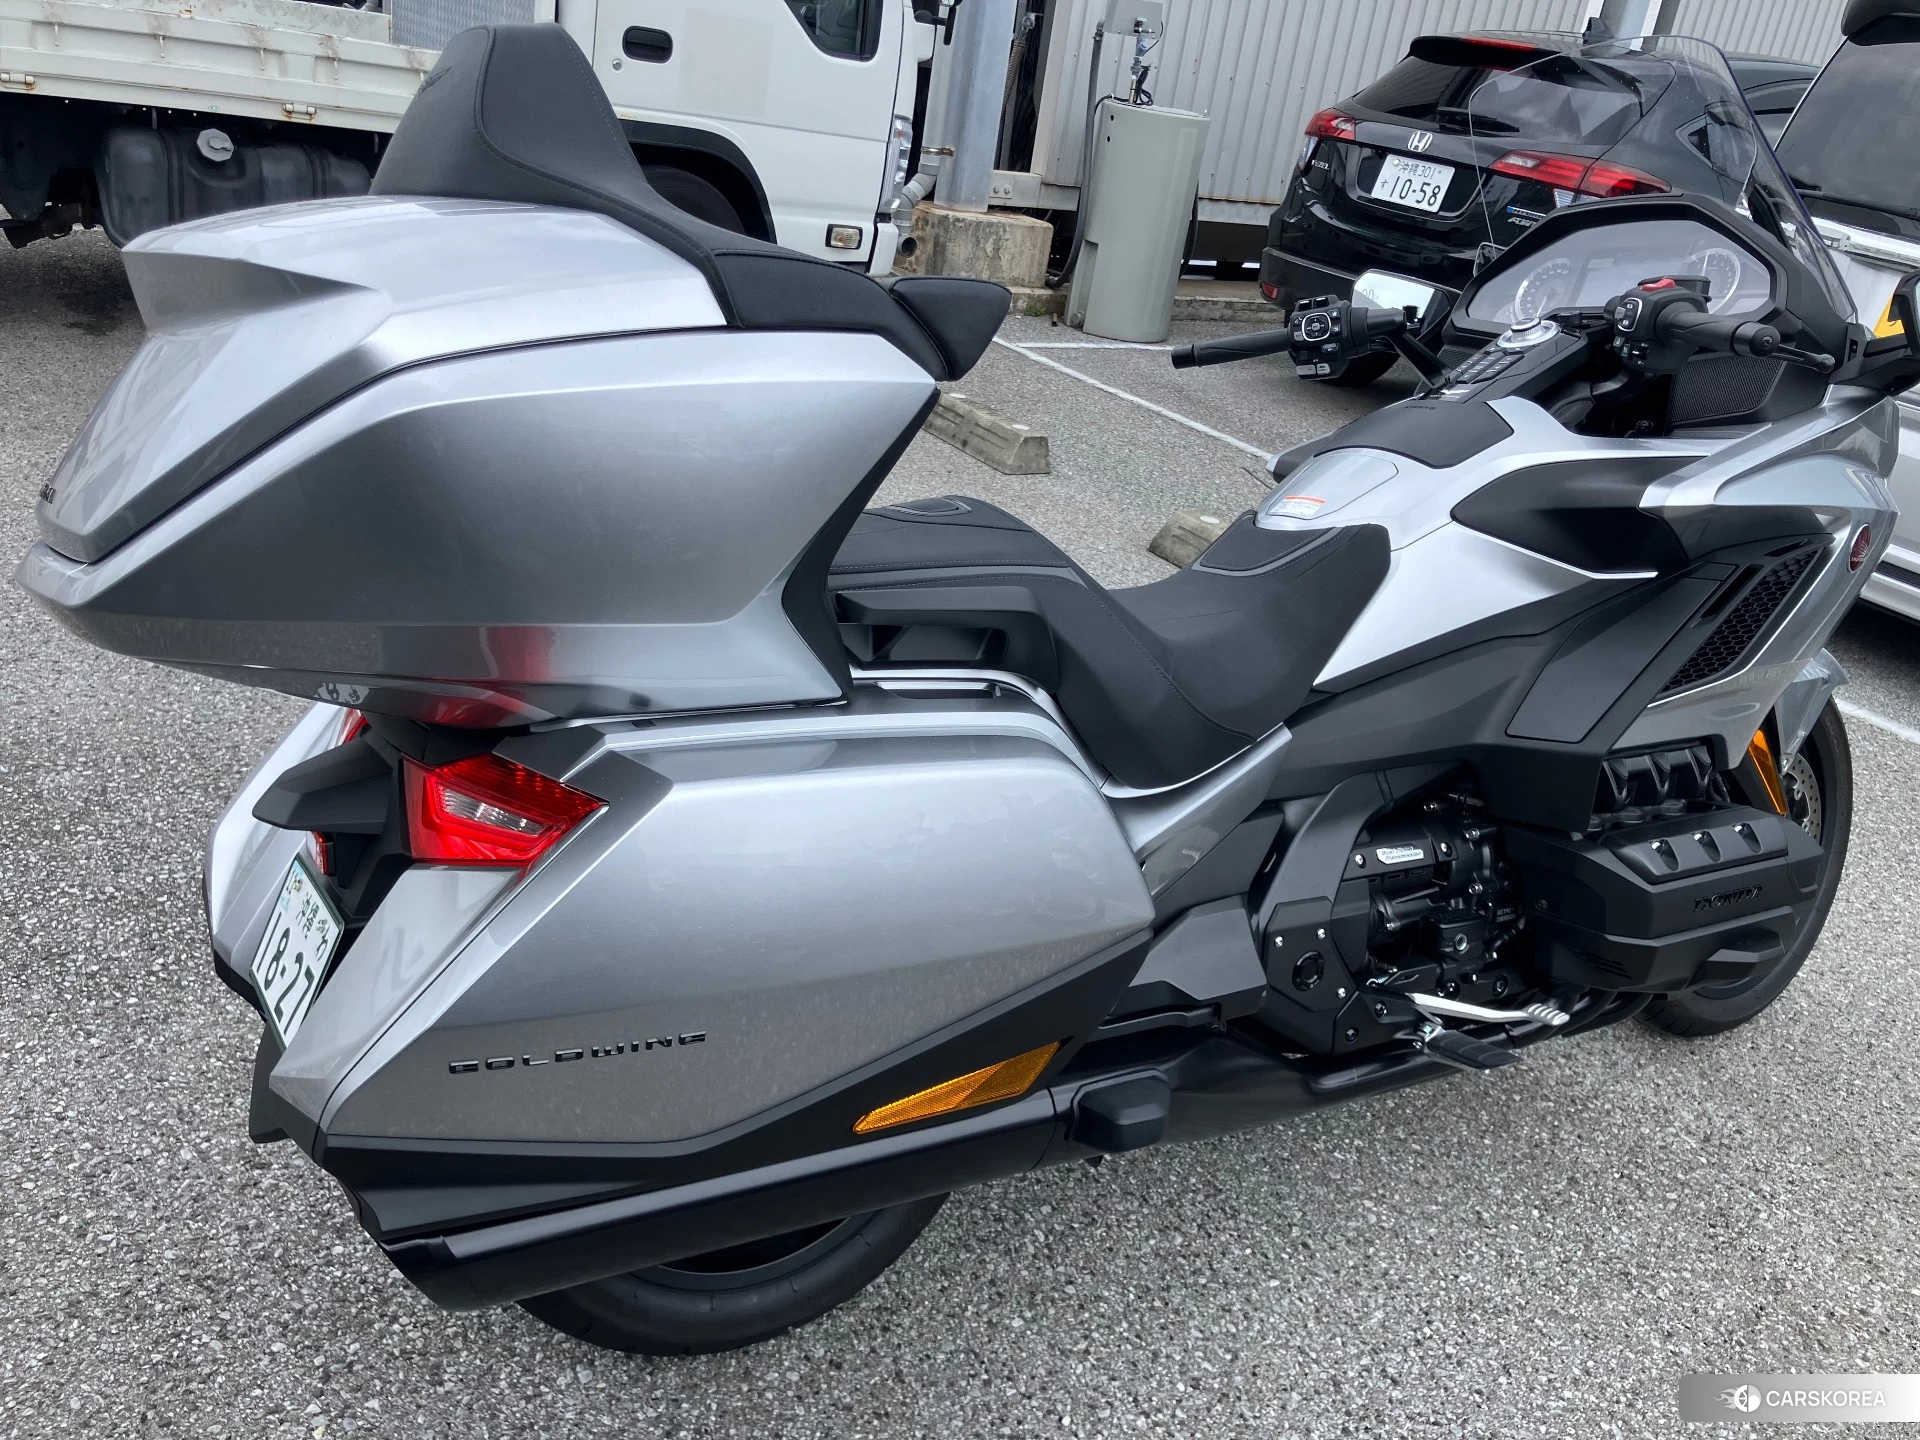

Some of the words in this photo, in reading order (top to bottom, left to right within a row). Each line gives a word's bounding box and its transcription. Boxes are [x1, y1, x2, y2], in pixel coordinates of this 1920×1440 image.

[1390, 175, 1441, 207] 10-58
[256, 911, 316, 1037] 18-27
[449, 1030, 706, 1075] GOLDWING
